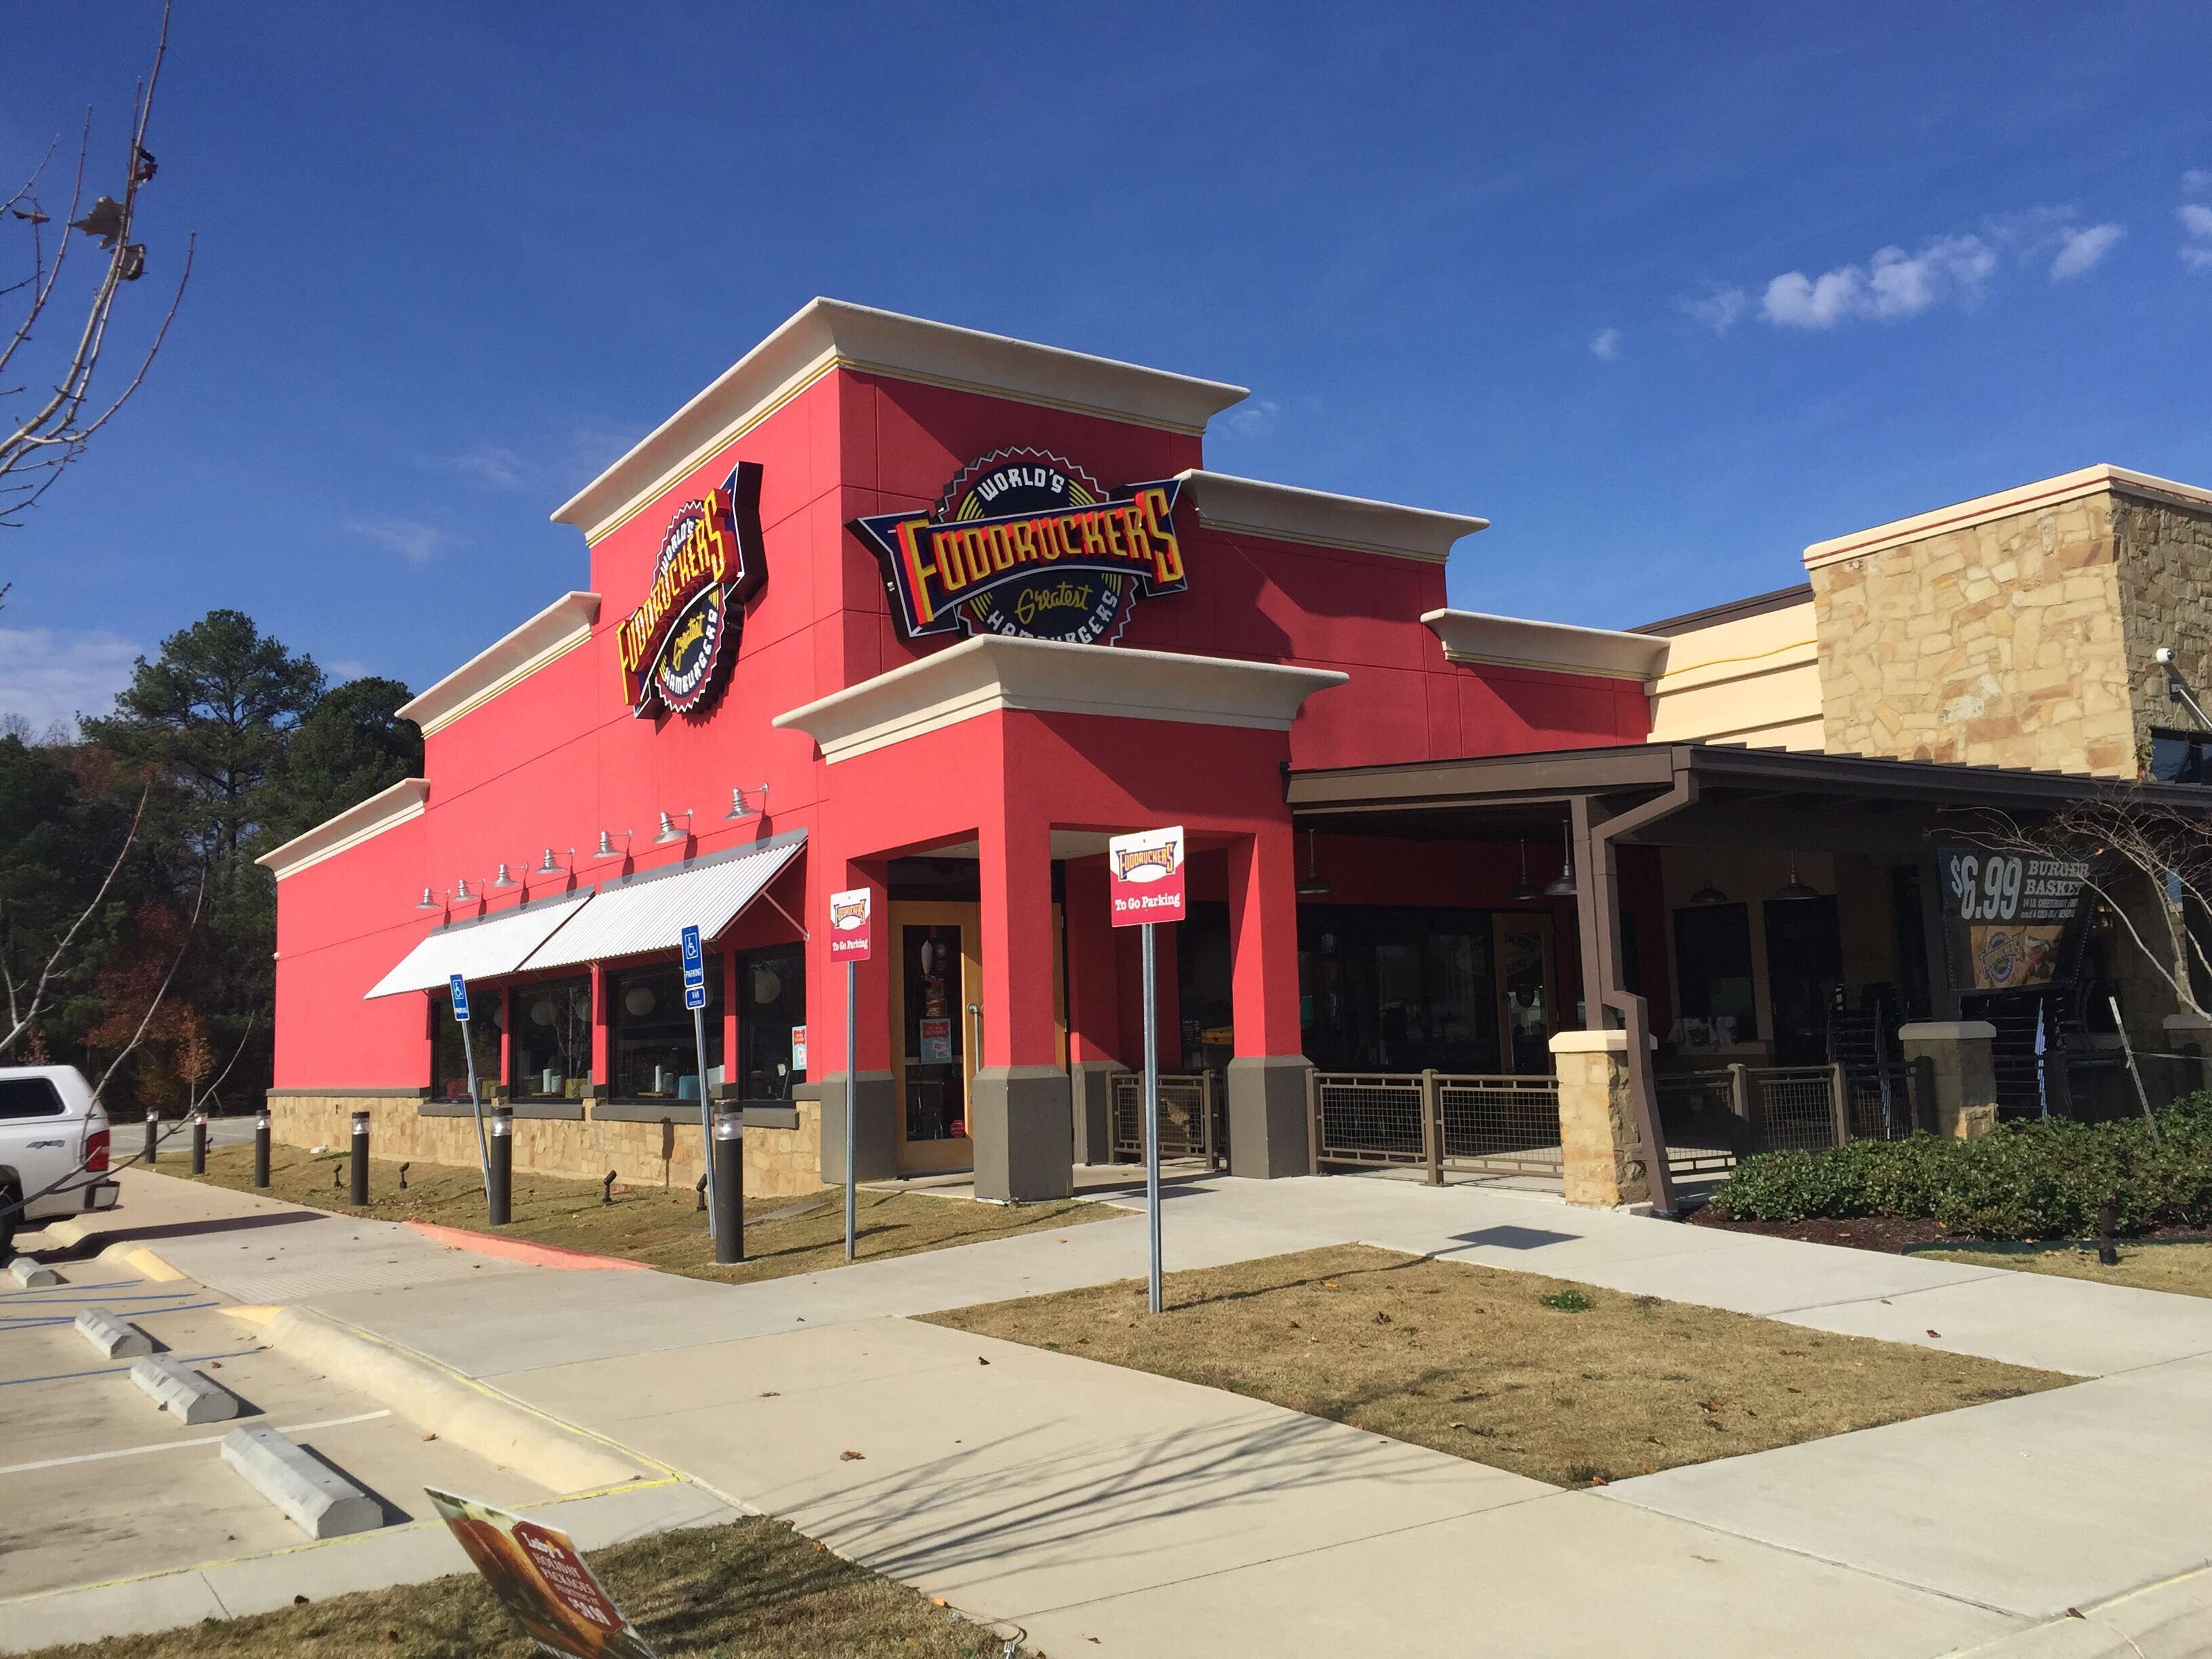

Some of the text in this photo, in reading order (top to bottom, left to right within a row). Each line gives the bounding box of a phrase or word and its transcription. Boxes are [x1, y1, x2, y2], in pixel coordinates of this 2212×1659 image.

[977, 468, 1065, 502] WORLD'S
[895, 488, 1184, 625] FUDDRUCKERS
[615, 489, 728, 705] FUDDRUCKERS
[1015, 581, 1094, 625] Greatest
[986, 590, 1118, 644] HARGERS
[1118, 842, 1174, 880] FUDDRUCKERS
[2027, 859, 2090, 878] BURGER
[1114, 893, 1181, 912] To Go Parking
[1950, 855, 2023, 920] $6.99
[832, 938, 868, 951] To Go Parking
[684, 968, 702, 979] PARKING
[532, 1553, 581, 1578] HOLIDAY
[540, 1567, 596, 1596] PACKAGES
